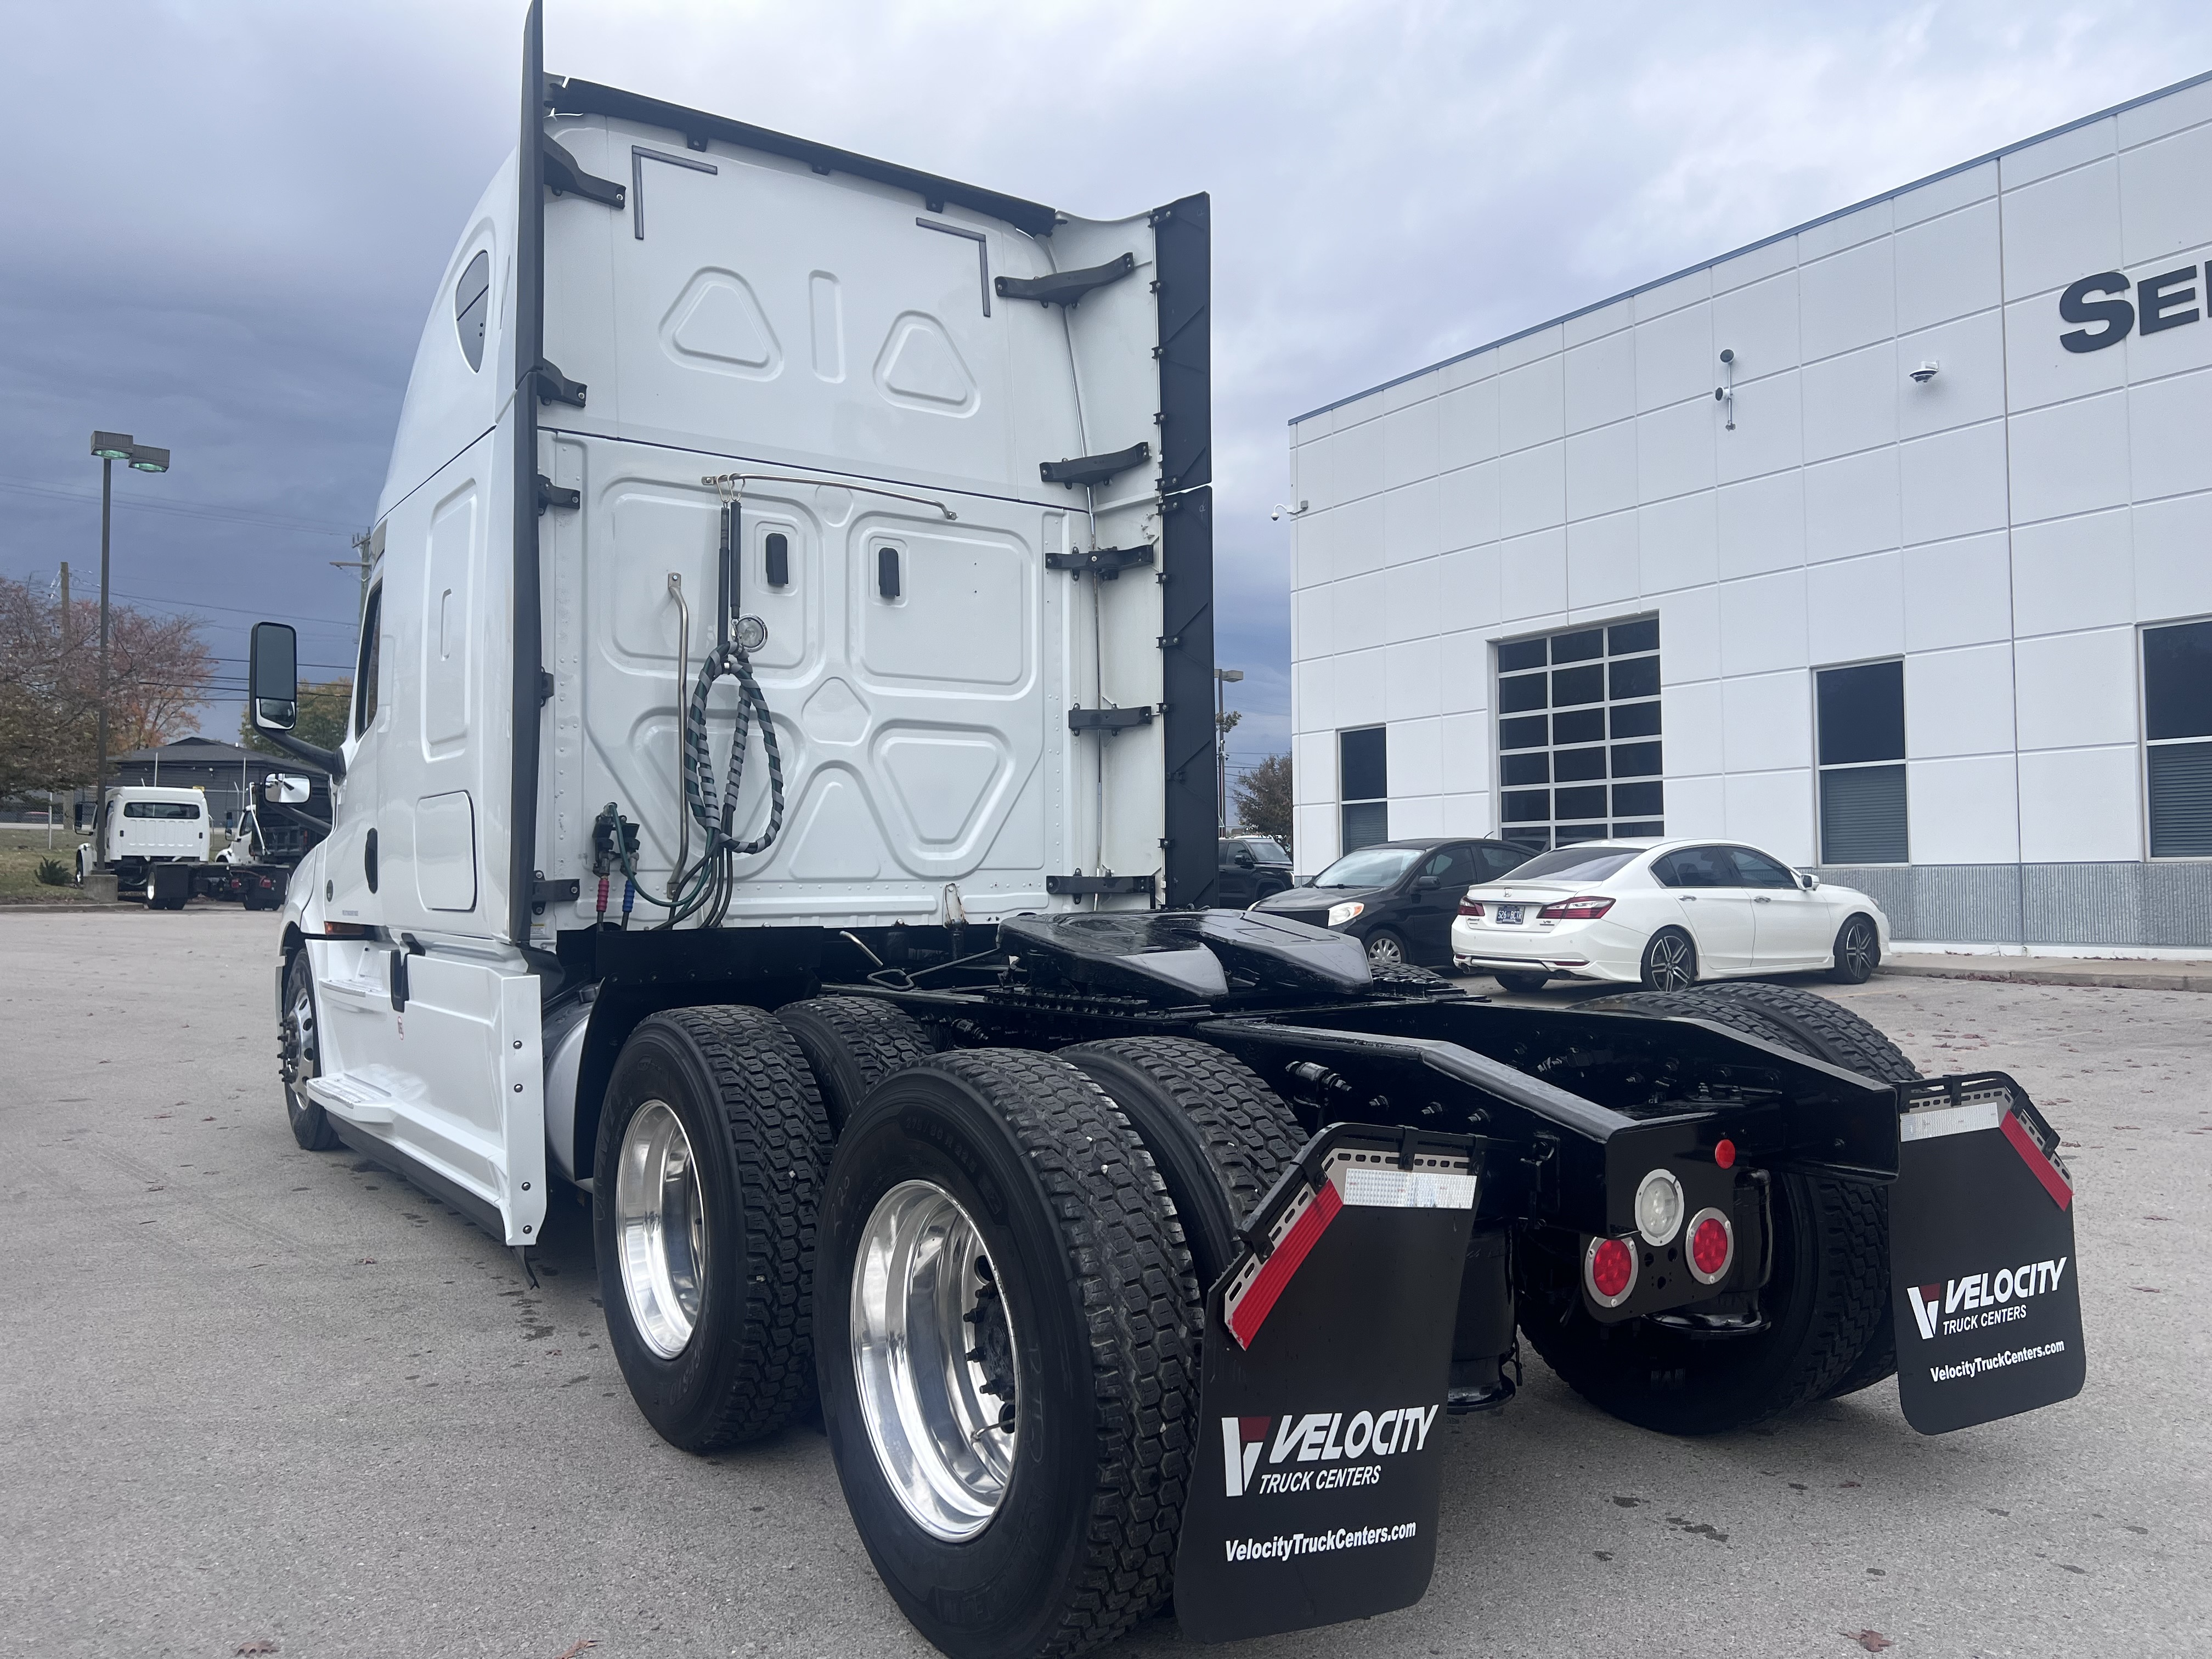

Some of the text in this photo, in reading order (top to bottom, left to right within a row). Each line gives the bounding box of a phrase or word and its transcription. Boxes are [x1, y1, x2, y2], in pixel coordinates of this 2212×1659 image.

[2059, 260, 2212, 353] SE
[1497, 910, 1507, 919] 526
[1945, 1256, 2068, 1314] VELOCITY
[1943, 1304, 2027, 1335] TRUCK CENTERS
[1930, 1340, 2065, 1382] VelocityTruckCenters.com
[1269, 1404, 1439, 1464] VELOCITY
[1259, 1465, 1381, 1494] TRUCK CENTERS
[1226, 1522, 1417, 1562] VelocityTruckCenters.com
